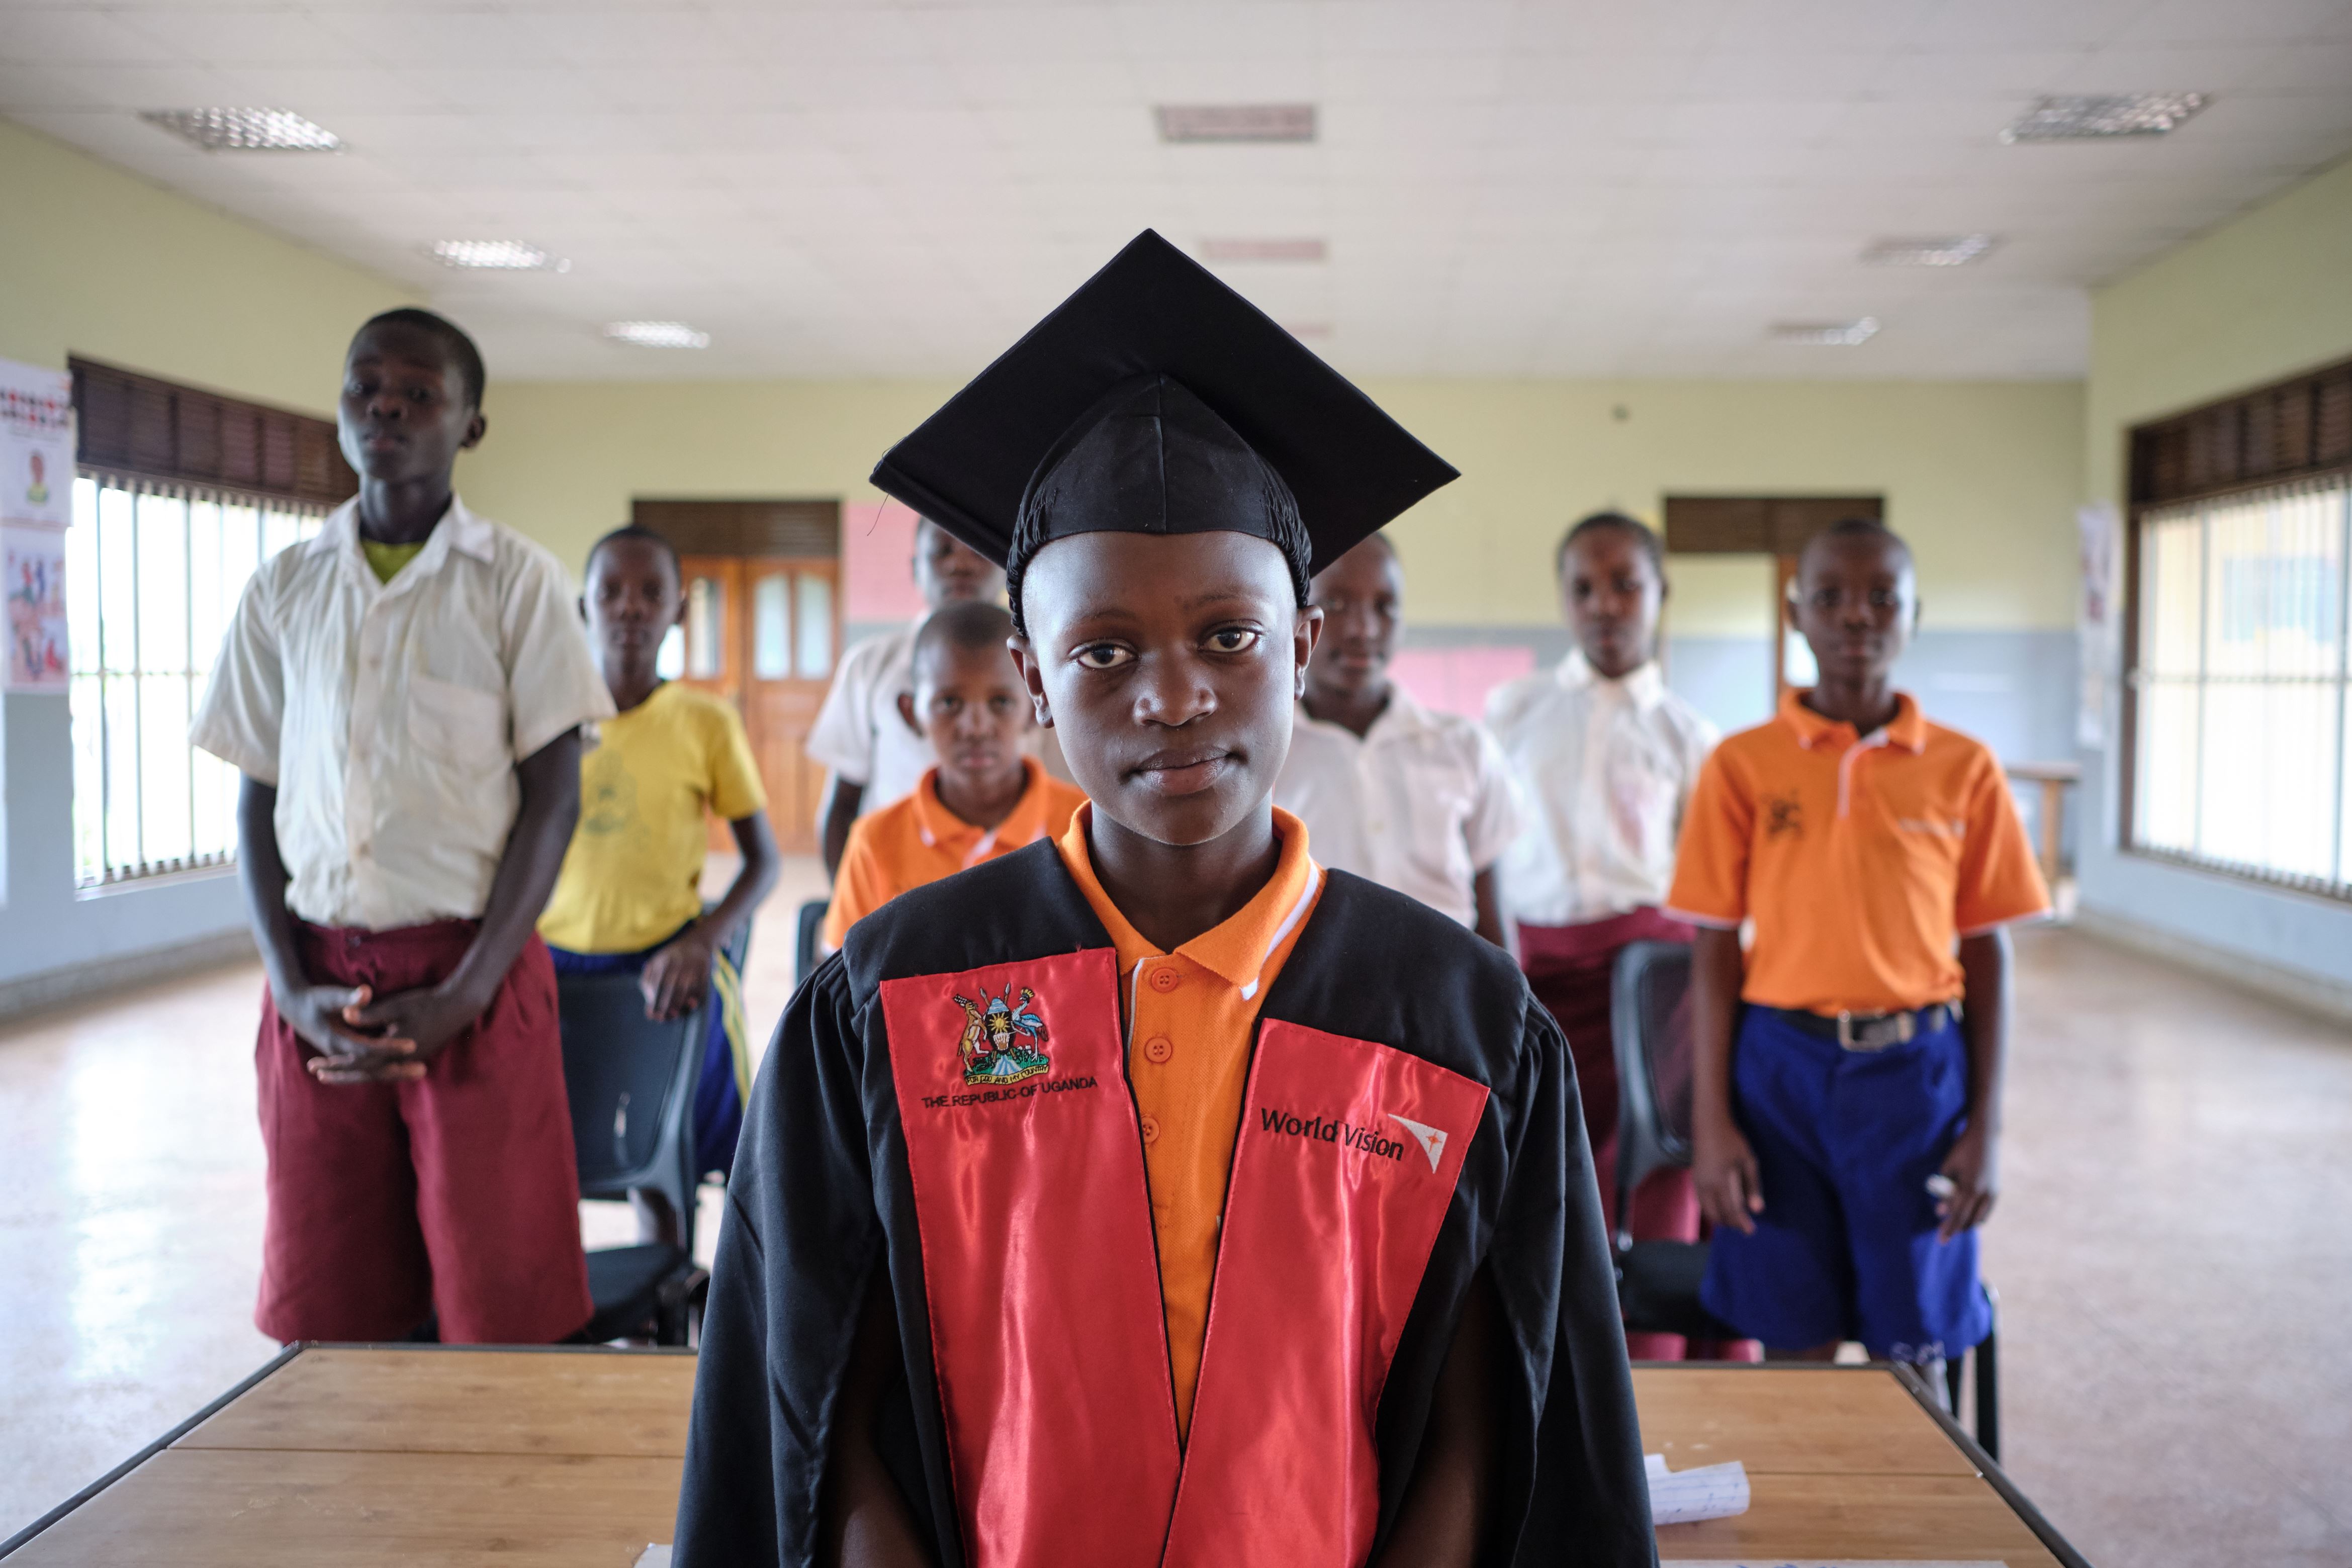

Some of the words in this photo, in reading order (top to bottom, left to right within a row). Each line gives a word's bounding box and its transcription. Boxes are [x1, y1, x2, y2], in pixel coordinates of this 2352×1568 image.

[1021, 1065, 1048, 1078] COUNTRY
[921, 1095, 949, 1108] THE
[952, 1088, 1017, 1106] REPUBLIC
[1020, 1084, 1038, 1097] OF
[1041, 1076, 1098, 1093] UGANDA
[1261, 1108, 1339, 1143] World
[1344, 1124, 1404, 1161] Vision
